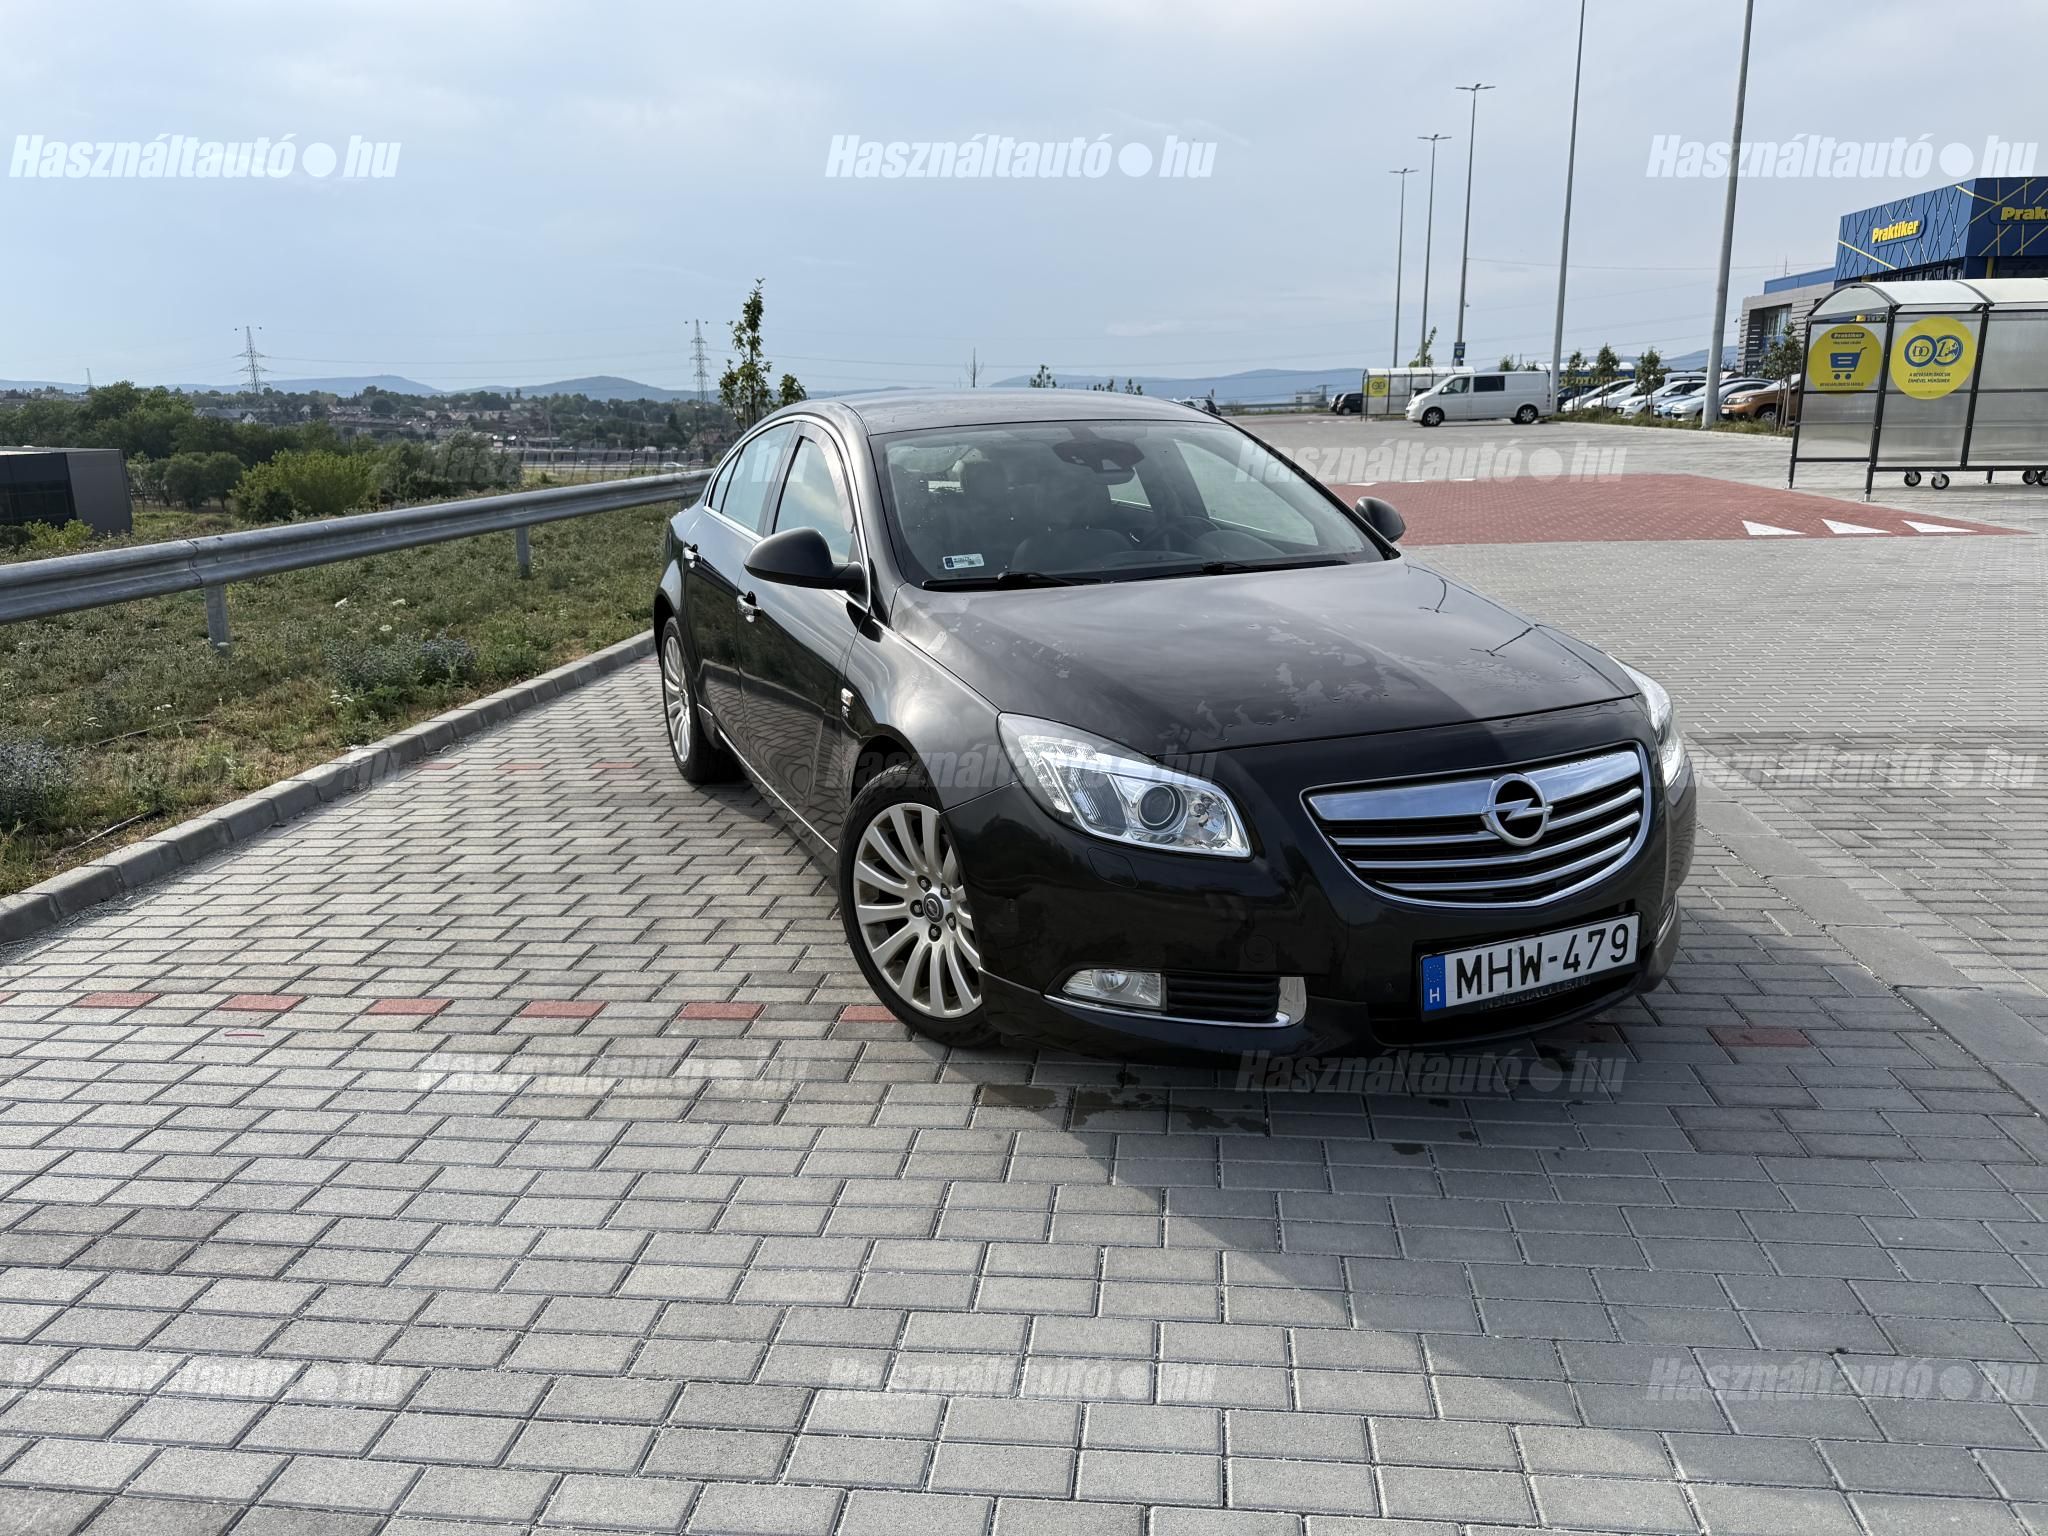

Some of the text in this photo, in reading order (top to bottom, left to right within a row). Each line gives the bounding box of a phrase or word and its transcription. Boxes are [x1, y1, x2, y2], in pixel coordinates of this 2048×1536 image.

[2000, 206, 2048, 220] Prak
[1871, 219, 1920, 244] Praktiker
[1456, 923, 1629, 999] MHW-479
[1429, 988, 1440, 1003] H
